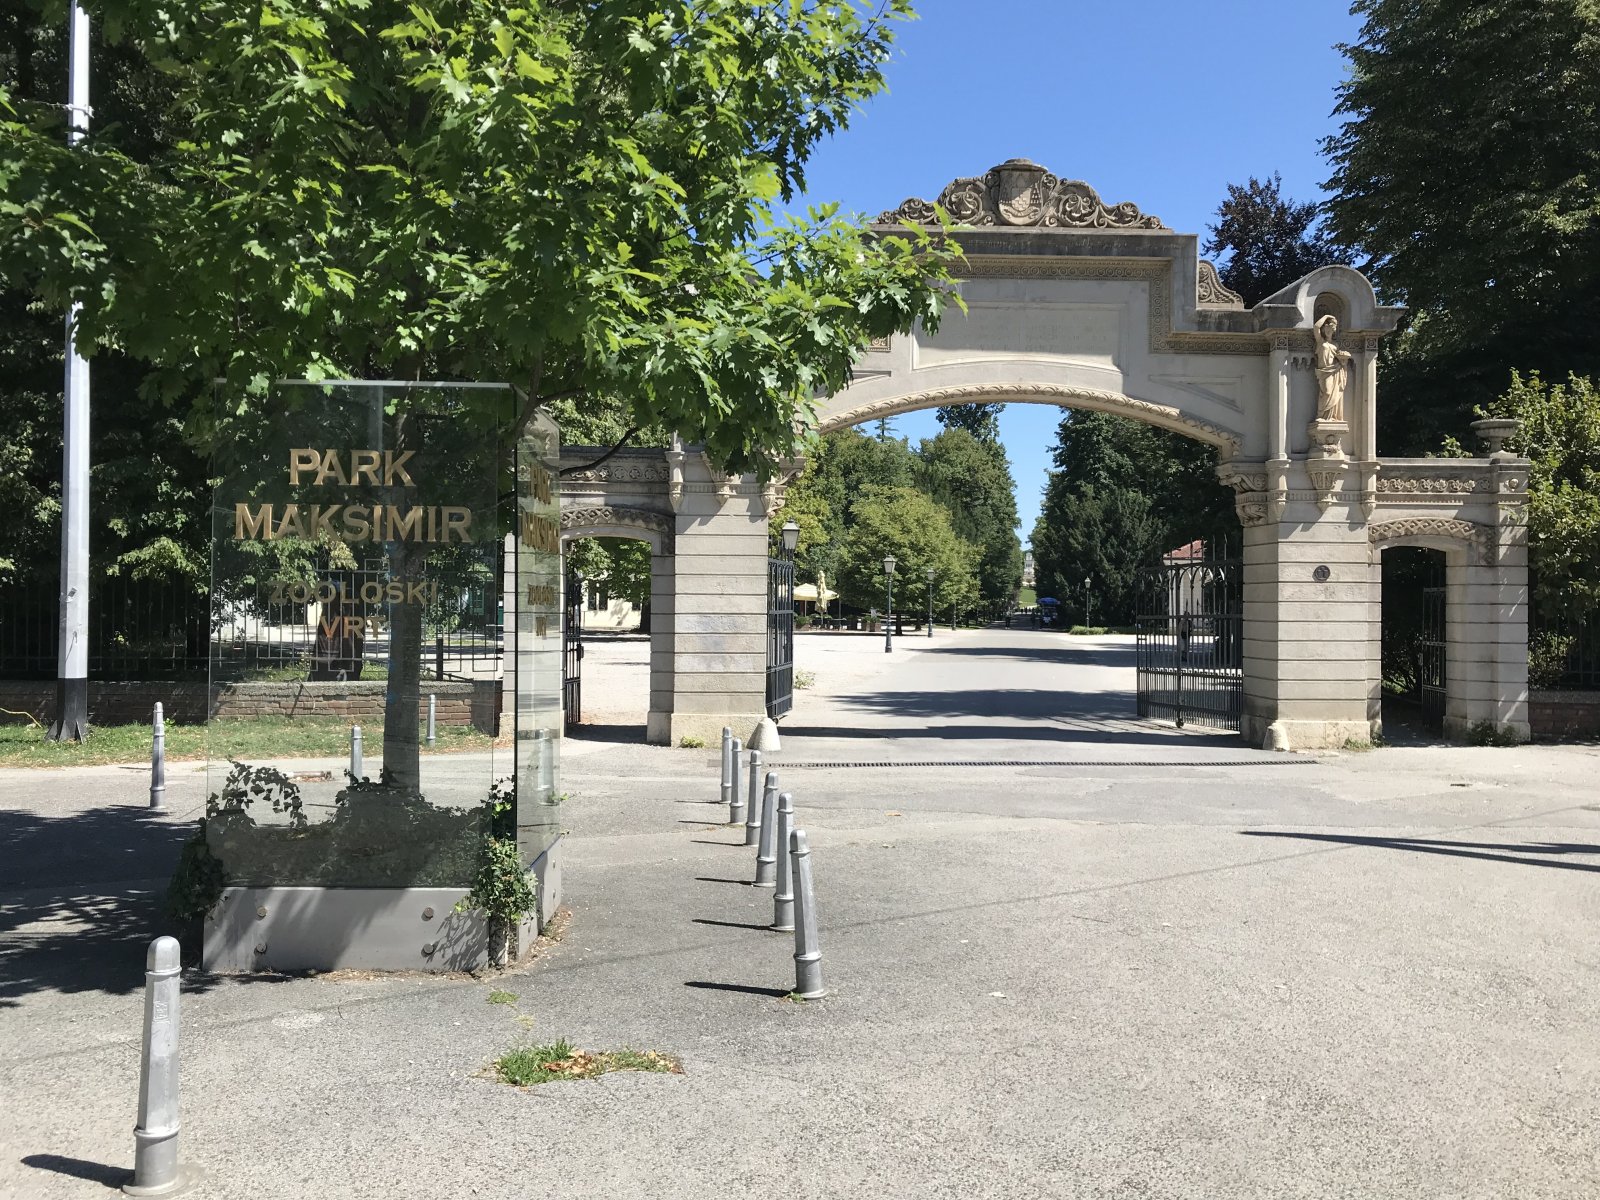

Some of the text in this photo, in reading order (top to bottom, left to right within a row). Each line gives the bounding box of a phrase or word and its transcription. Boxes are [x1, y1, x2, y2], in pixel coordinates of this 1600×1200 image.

[289, 448, 416, 486] PARK
[235, 503, 473, 543] MAKSIMIR
[268, 576, 439, 605] ZOOLOŠKI
[320, 615, 387, 640] VRT
